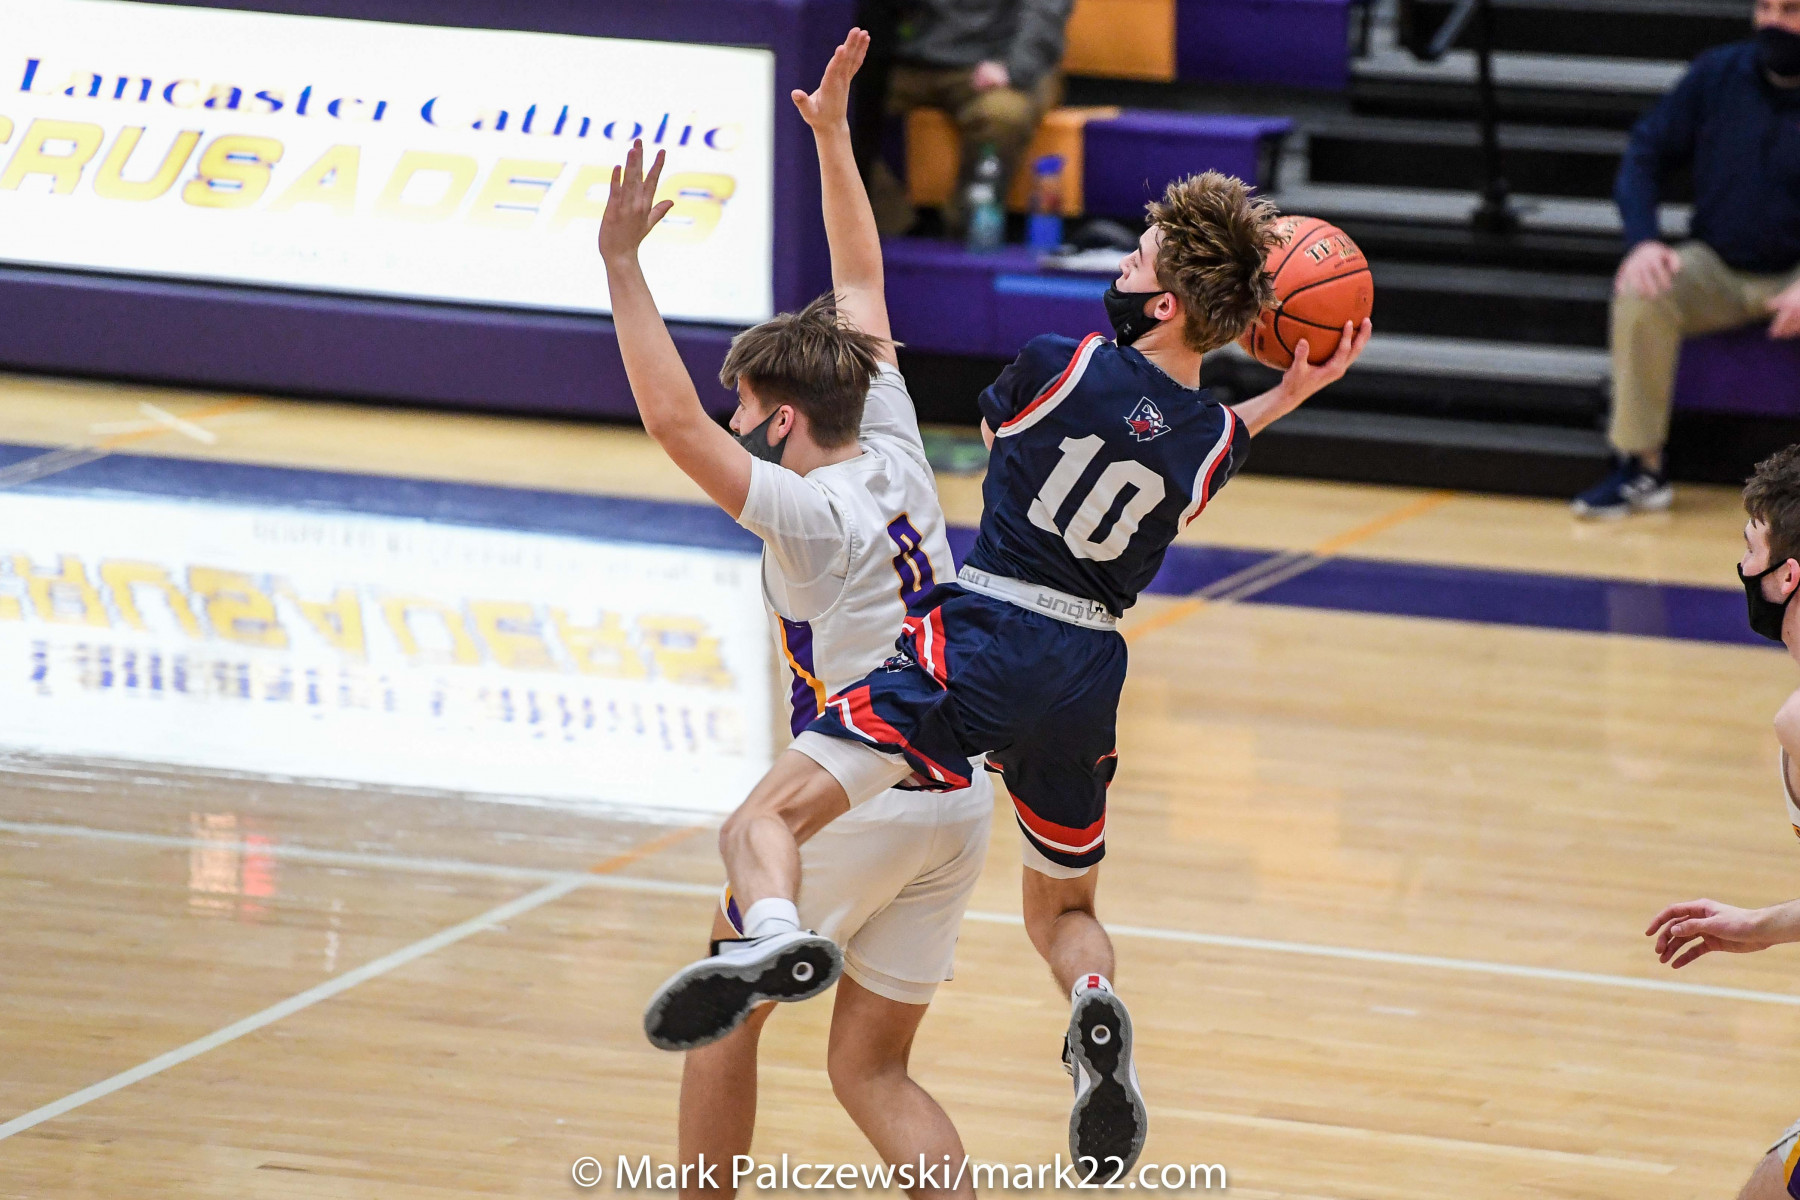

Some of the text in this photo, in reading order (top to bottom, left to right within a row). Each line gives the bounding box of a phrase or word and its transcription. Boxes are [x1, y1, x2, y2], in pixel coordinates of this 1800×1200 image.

[19, 57, 743, 152] Lancaster Catholic
[1027, 433, 1166, 562] 10
